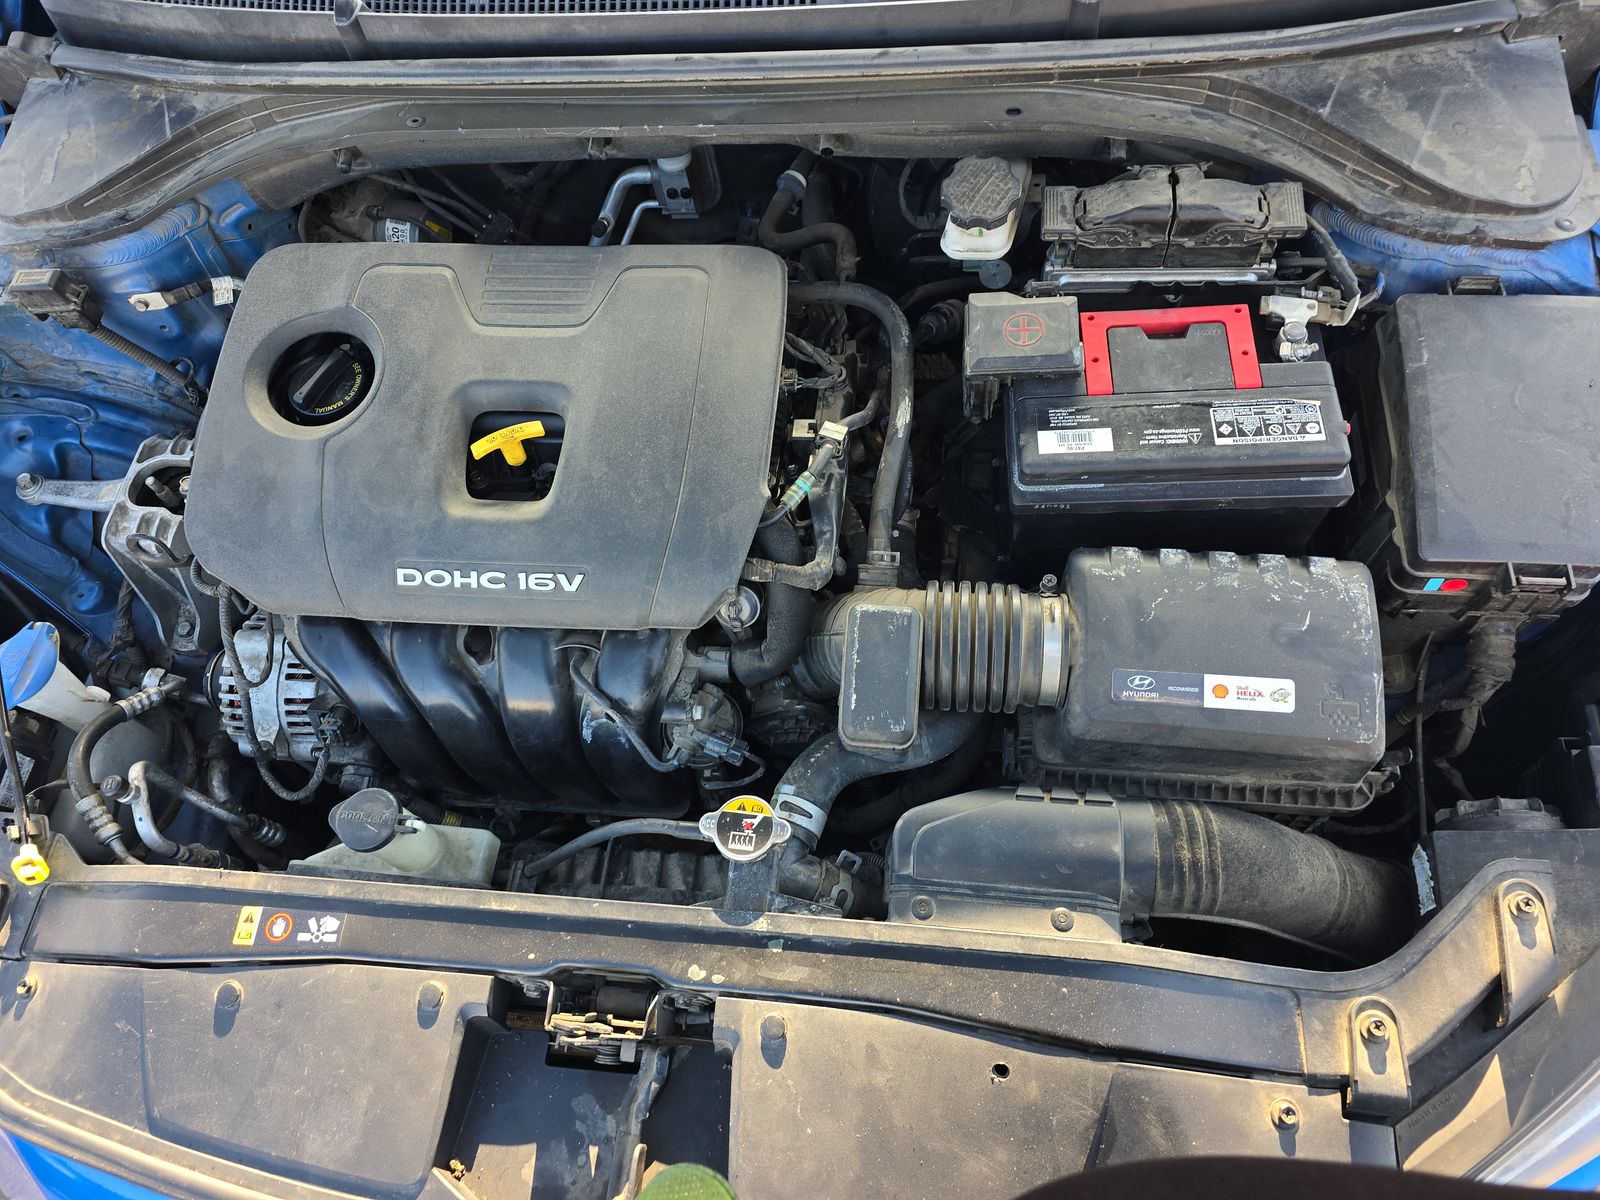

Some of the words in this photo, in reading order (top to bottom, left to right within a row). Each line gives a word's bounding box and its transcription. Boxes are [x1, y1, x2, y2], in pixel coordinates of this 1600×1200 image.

[352, 362, 362, 373] SEE
[344, 374, 362, 401] OWNER'S
[314, 400, 344, 413] MANUAL
[396, 568, 507, 589] DOHC
[518, 573, 585, 592] 16V
[1122, 690, 1159, 698] HYUNDAI
